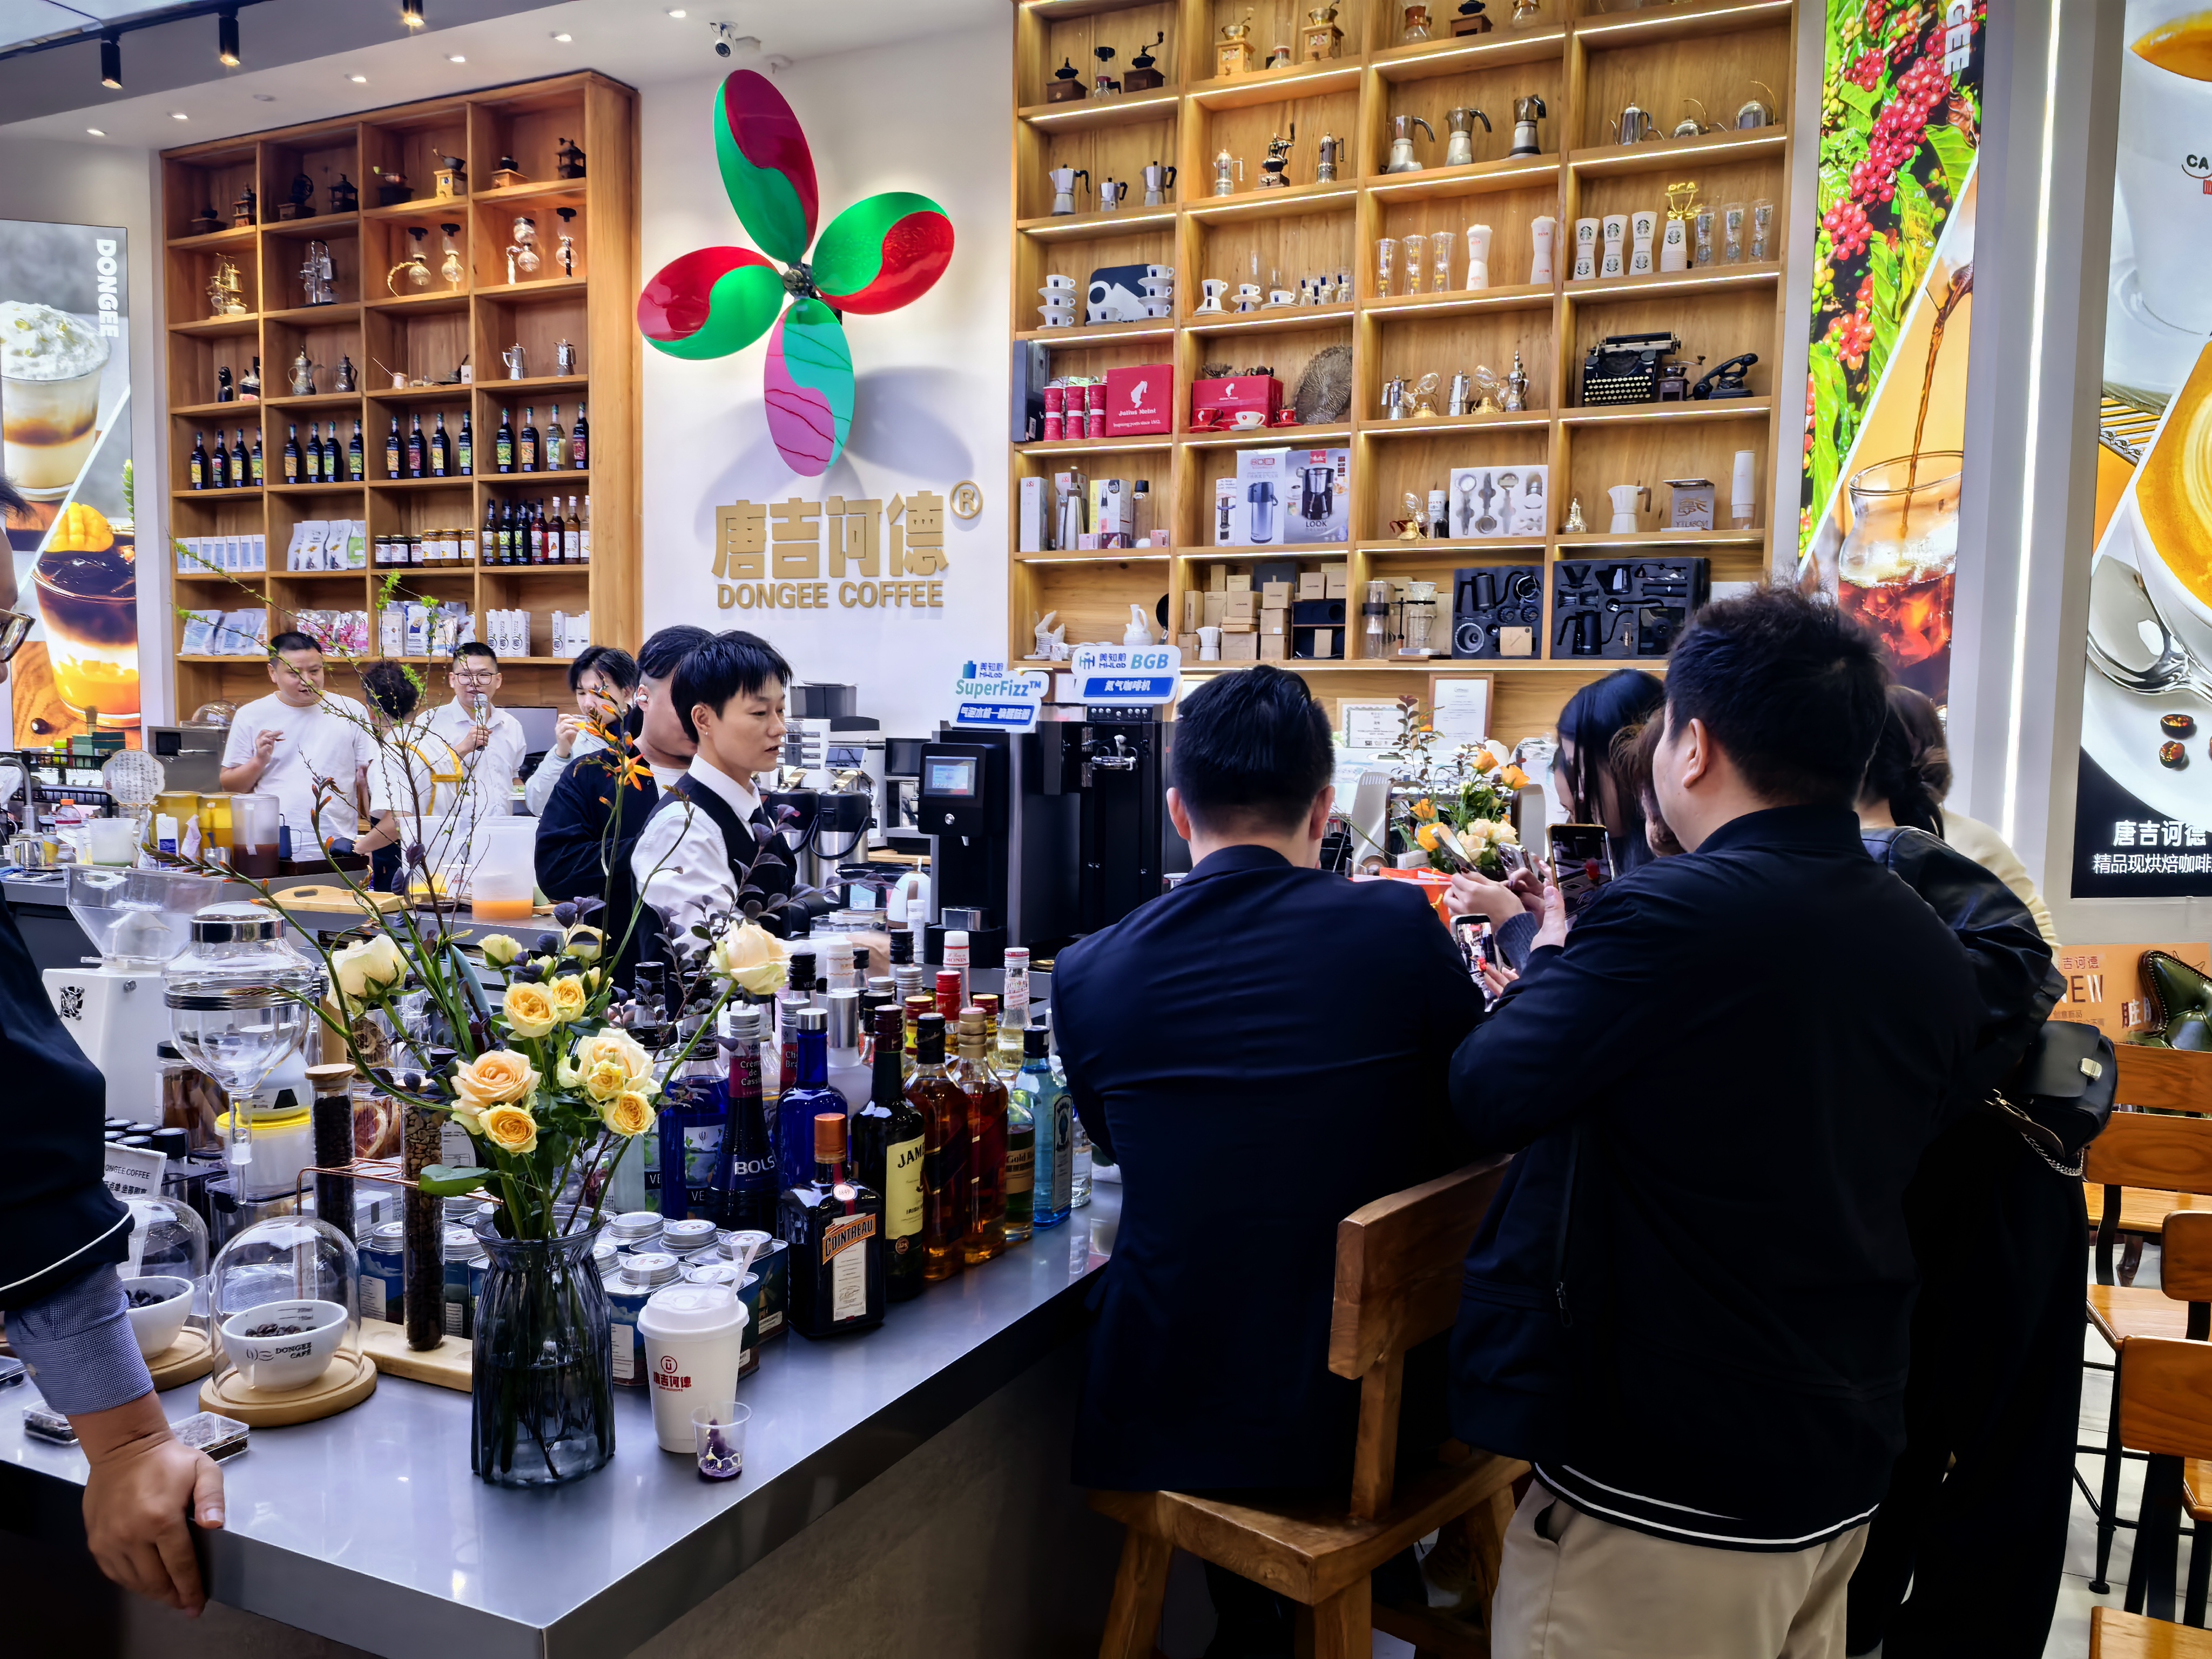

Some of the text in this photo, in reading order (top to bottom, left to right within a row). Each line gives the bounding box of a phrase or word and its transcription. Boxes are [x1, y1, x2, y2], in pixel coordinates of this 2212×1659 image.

[96, 239, 119, 338] DONGEE
[717, 581, 944, 609] DONGEE COFFEE
[1130, 653, 1169, 669] BGB
[2112, 820, 2207, 847] 唐吉诃德
[126, 1168, 151, 1179] COFFEE
[734, 1155, 776, 1176] BOLS
[825, 1219, 873, 1258] COINTREAU
